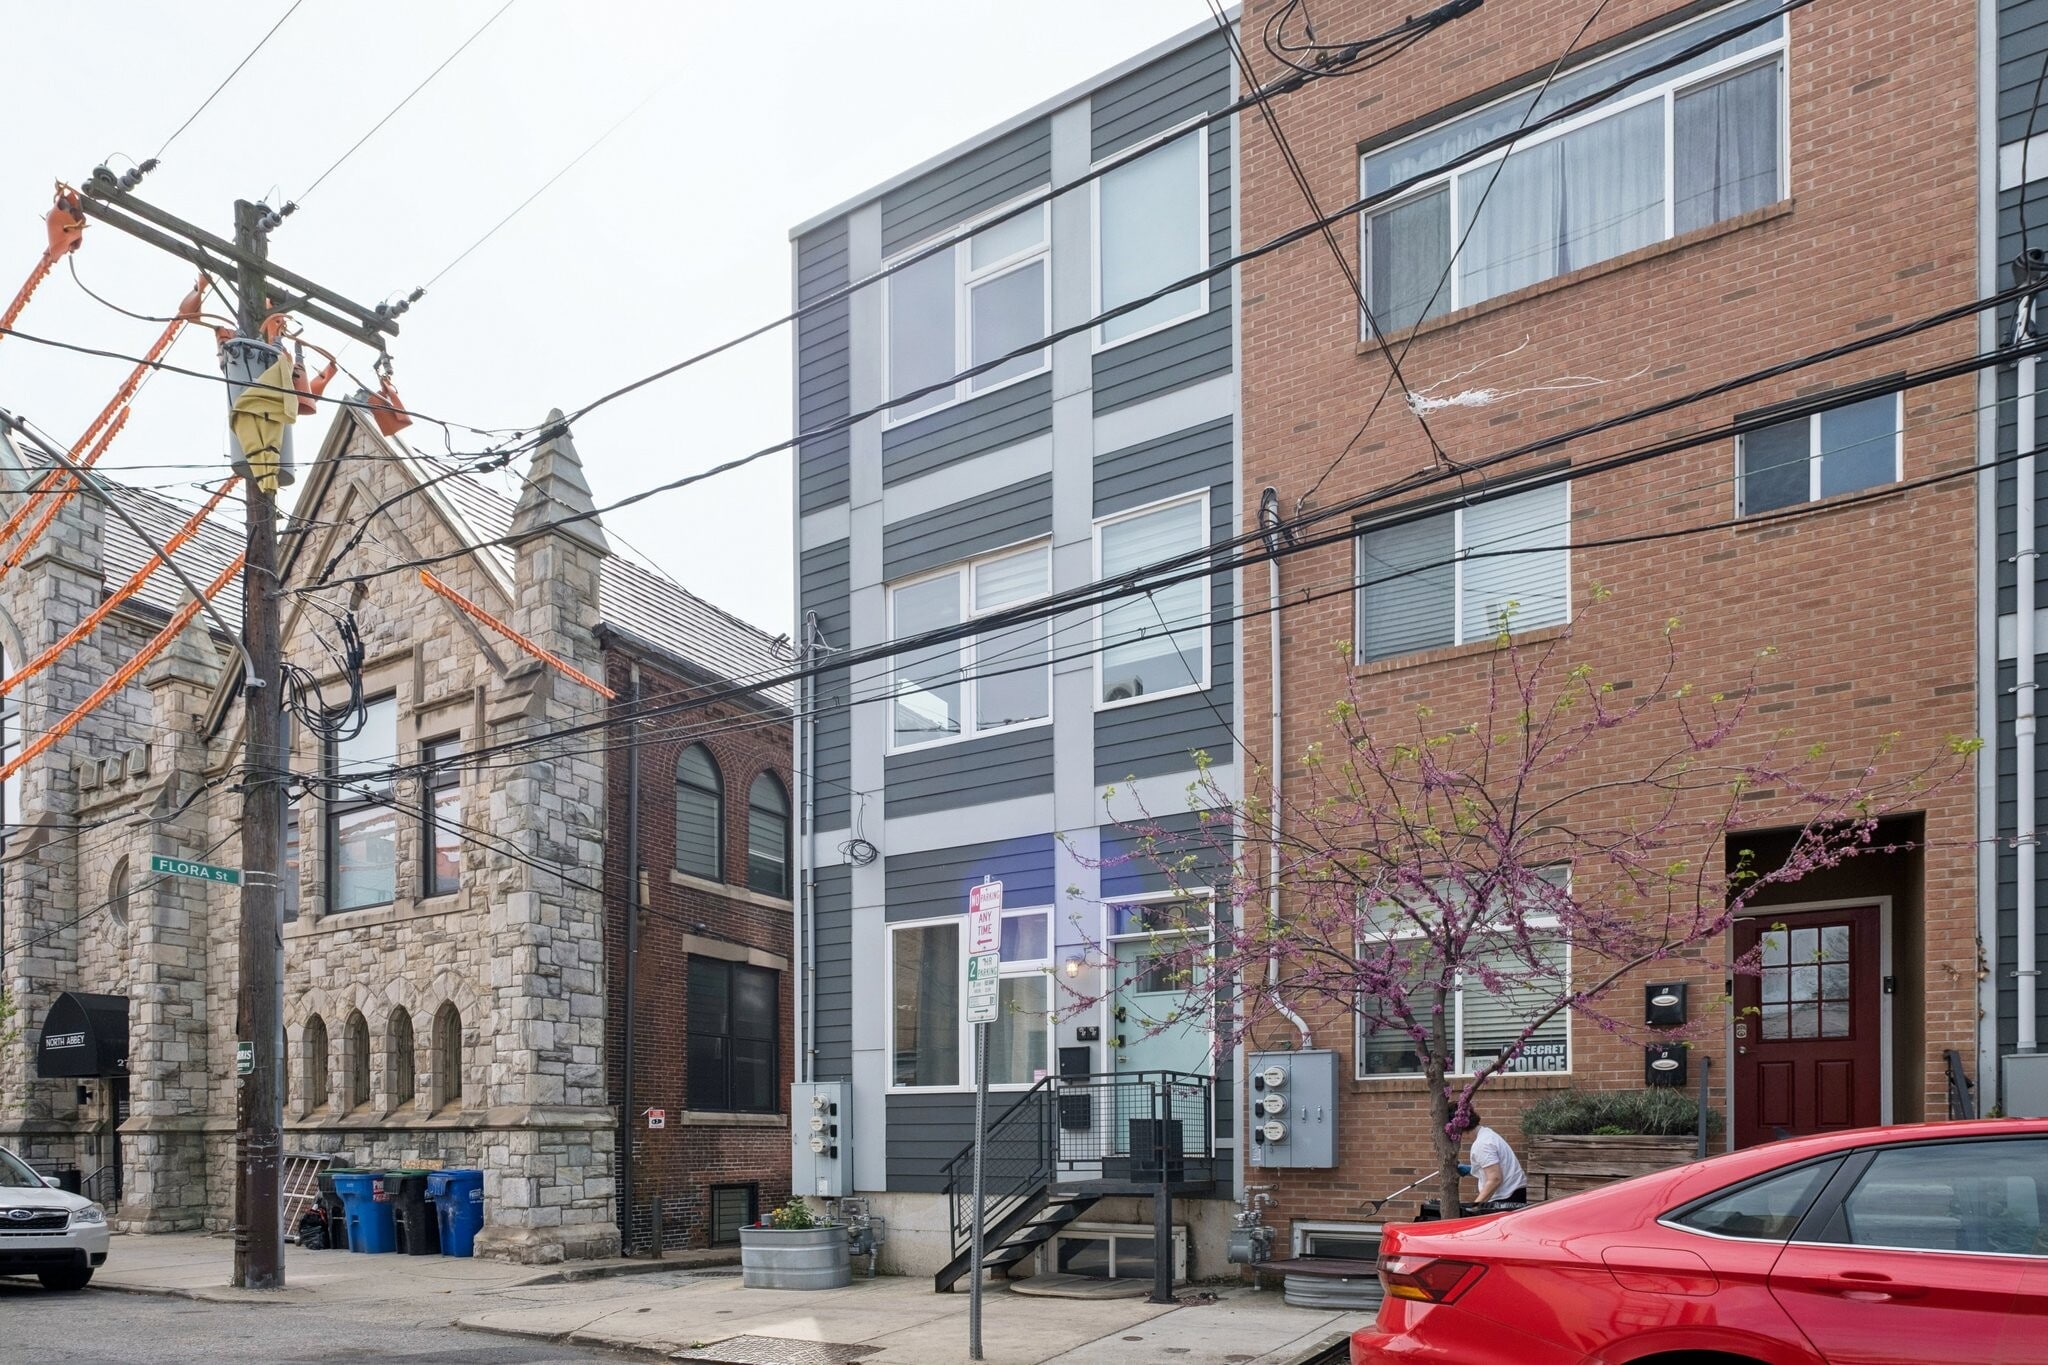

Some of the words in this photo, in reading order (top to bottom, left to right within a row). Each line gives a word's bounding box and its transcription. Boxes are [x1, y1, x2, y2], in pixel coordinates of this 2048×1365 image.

[159, 860, 210, 878] FLORA
[215, 871, 228, 881] St
[971, 894, 980, 907] NO
[980, 890, 1000, 903] PARKING
[978, 911, 992, 924] ANY
[978, 924, 993, 936] TIME
[969, 960, 976, 978] 2
[978, 967, 997, 977] PARKING
[45, 1037, 65, 1047] NORTH
[66, 1035, 85, 1045] ABBEY
[1523, 1045, 1565, 1055] SECRET
[1506, 1056, 1565, 1072] POLICE
